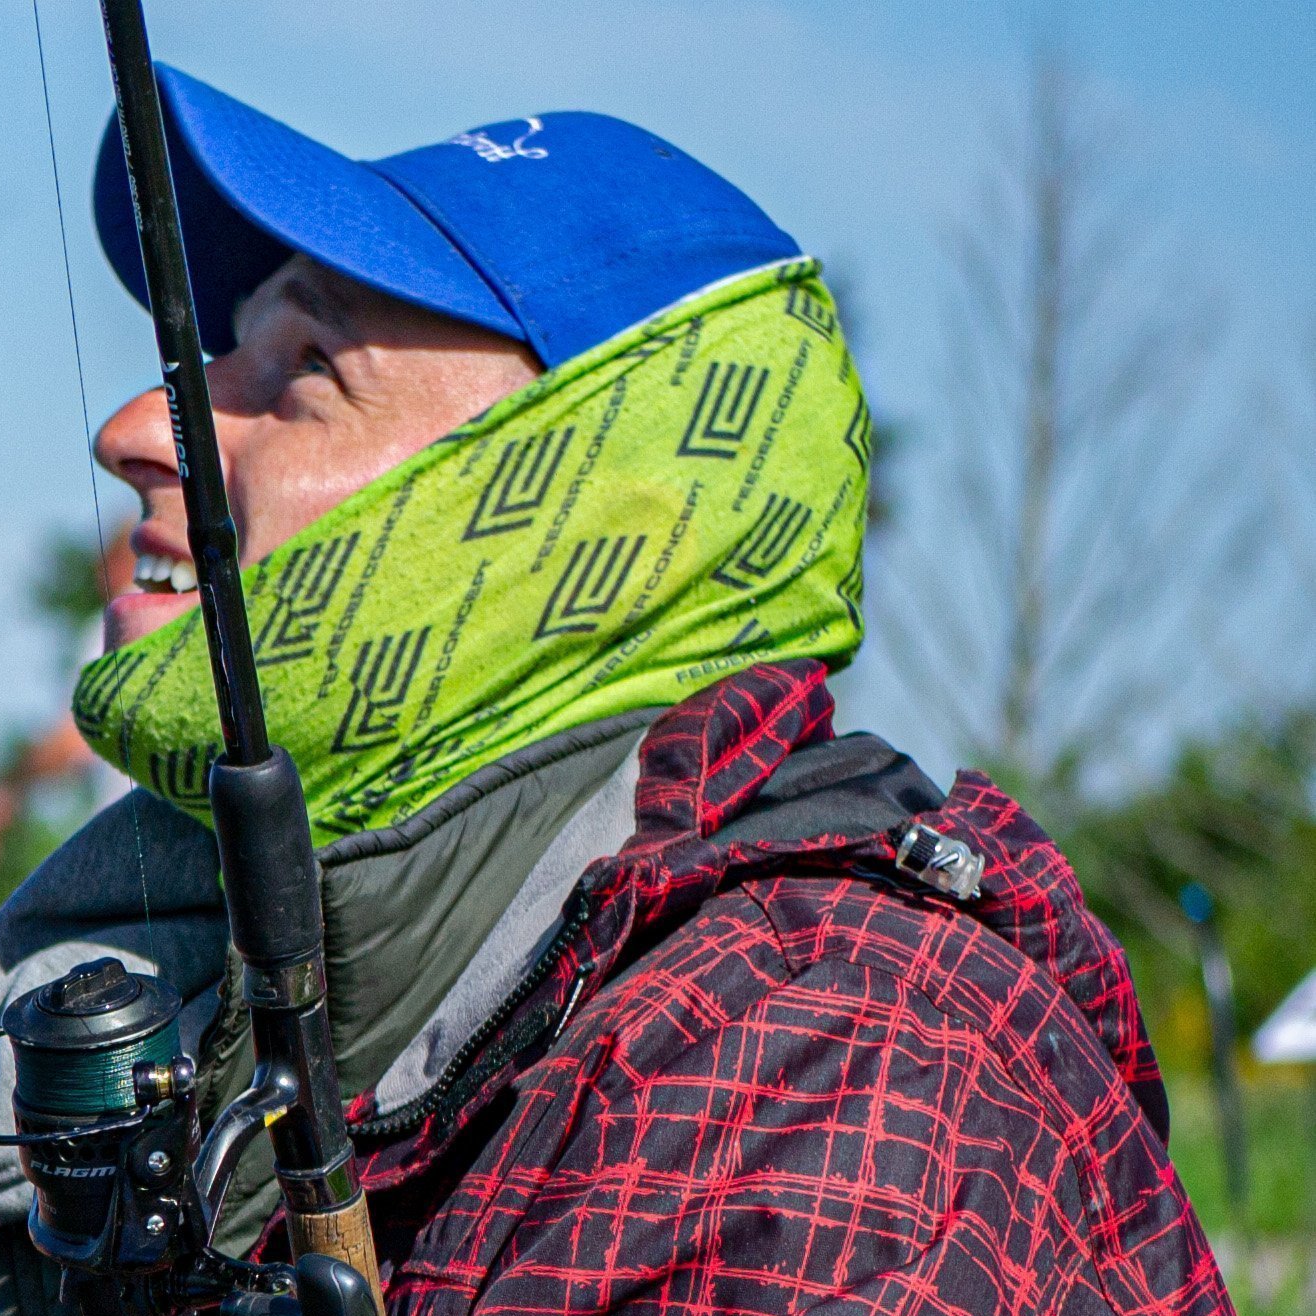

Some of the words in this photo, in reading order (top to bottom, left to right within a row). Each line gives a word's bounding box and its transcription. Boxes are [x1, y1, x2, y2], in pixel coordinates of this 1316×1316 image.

[530, 478, 586, 573] FEEDER
[578, 374, 628, 477] CONCEP
[732, 427, 778, 513] FEEDER
[771, 338, 813, 425] CONCEPT
[645, 478, 705, 591] CONCEPT
[435, 559, 493, 673] CONCEPT
